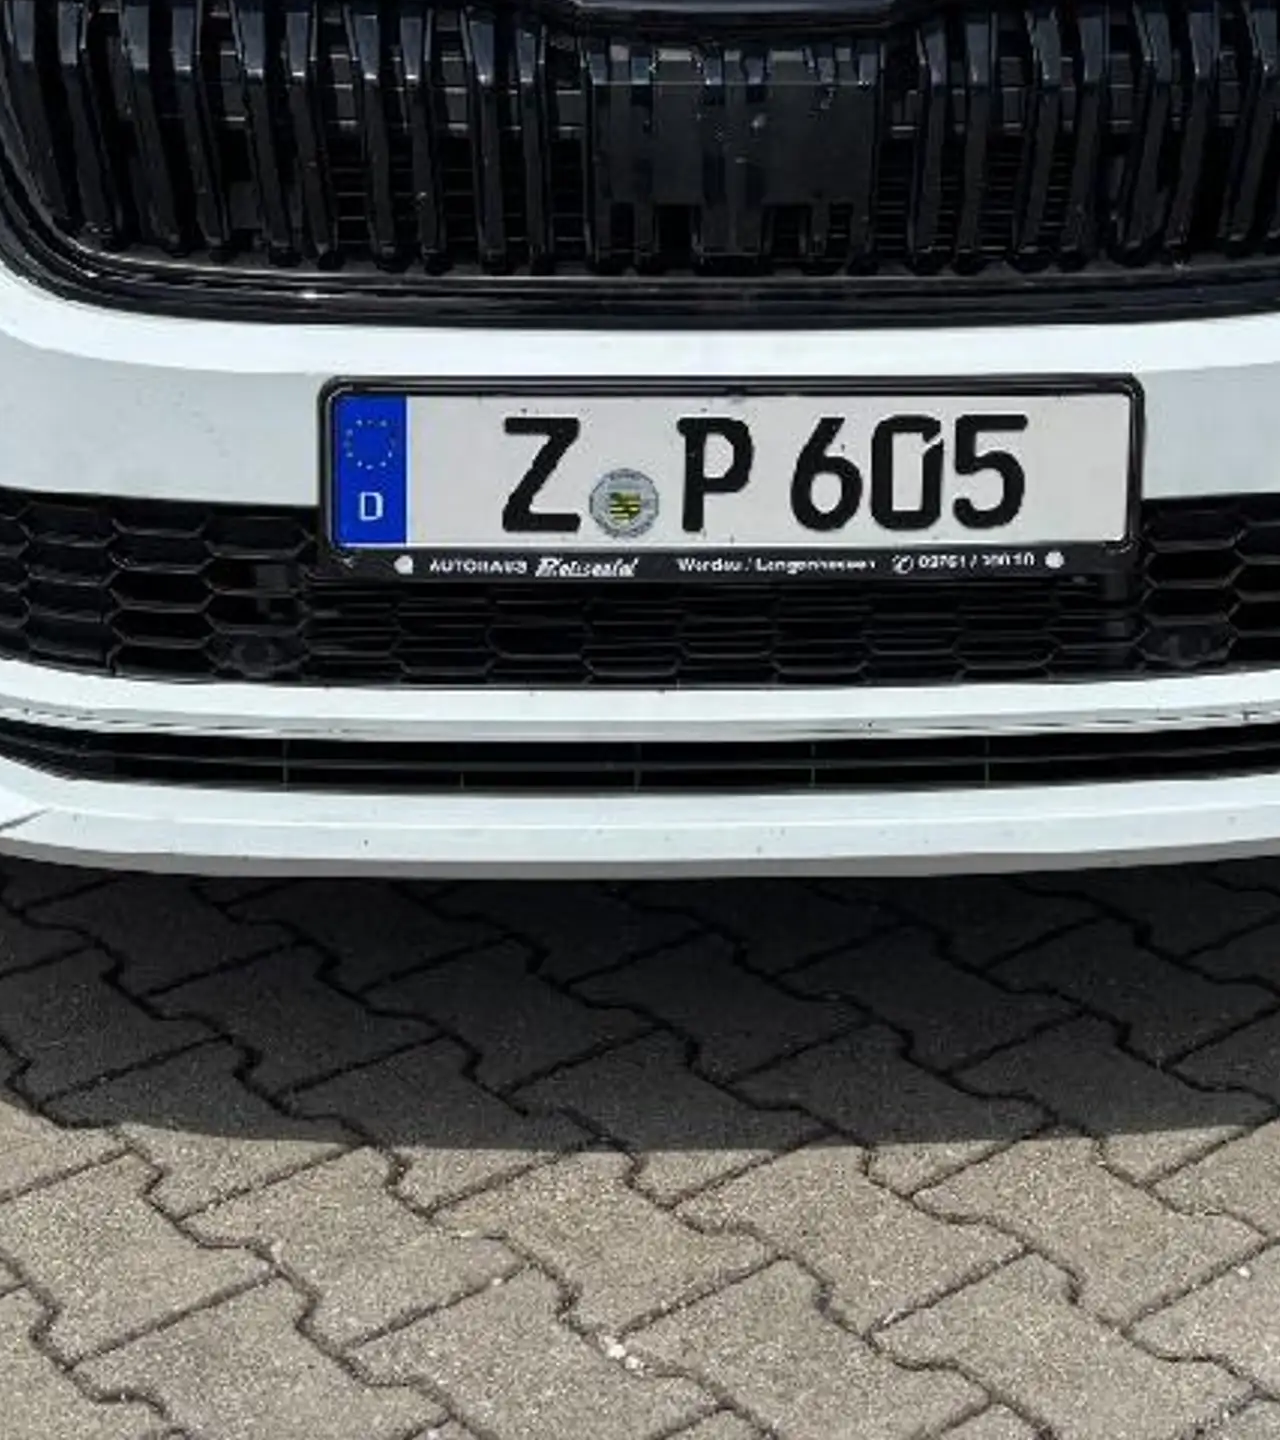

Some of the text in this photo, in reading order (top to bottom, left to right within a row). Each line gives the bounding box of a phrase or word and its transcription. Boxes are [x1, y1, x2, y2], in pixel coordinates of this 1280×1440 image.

[501, 416, 582, 532] Z
[677, 416, 755, 532] P
[790, 414, 1029, 531] 605
[359, 491, 384, 521] D
[429, 557, 528, 574] AUTOHAUS
